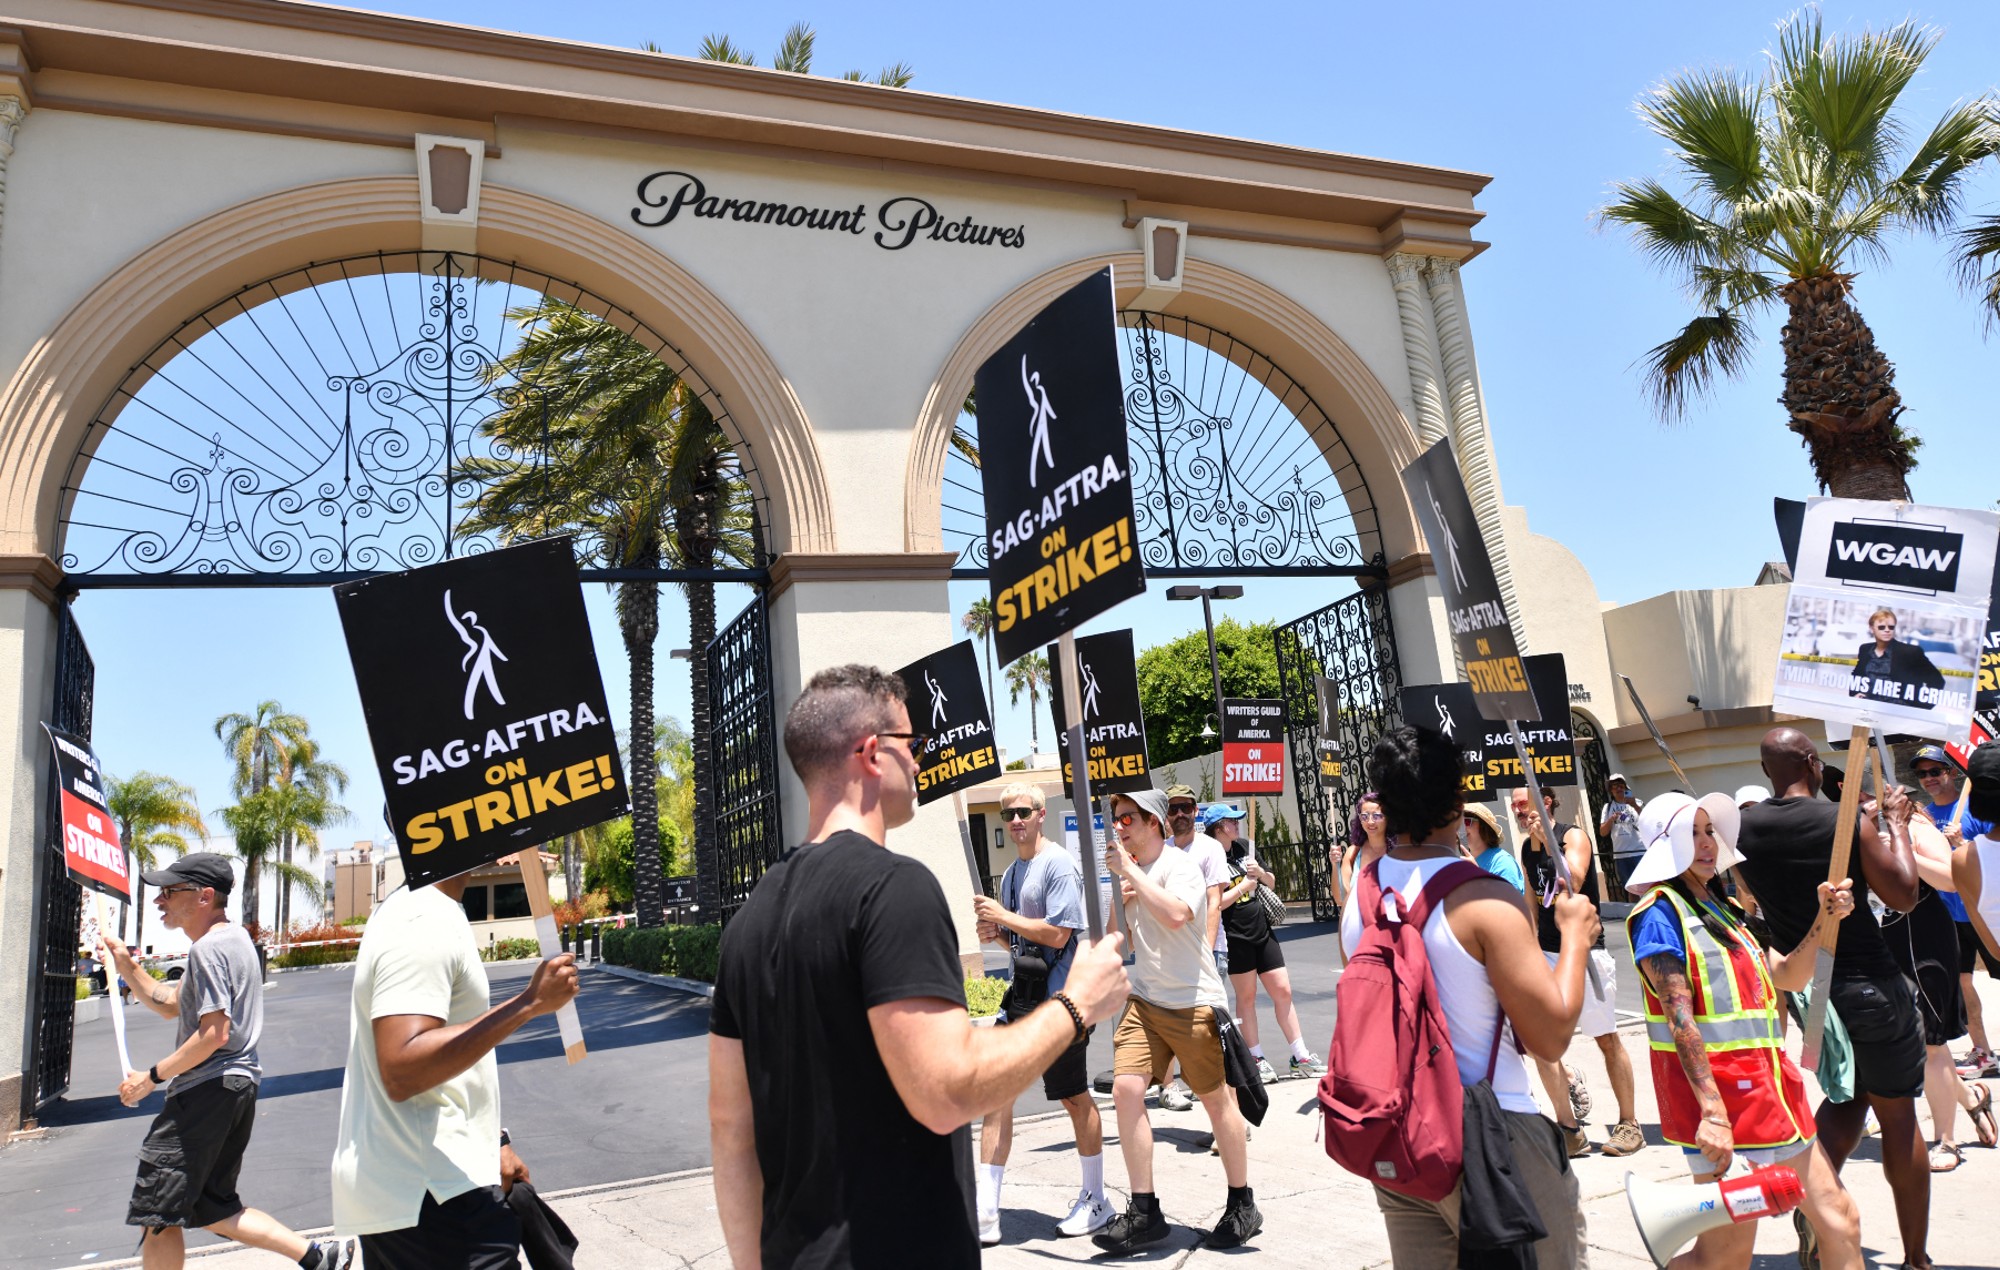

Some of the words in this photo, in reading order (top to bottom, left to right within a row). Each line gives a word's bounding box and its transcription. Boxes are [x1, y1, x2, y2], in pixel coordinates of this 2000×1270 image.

[631, 171, 865, 234] Paramount
[874, 197, 1025, 250] Pictures
[1041, 525, 1067, 559] ON
[1835, 539, 1956, 572] WGAW
[996, 516, 1132, 632] STRIKE!
[1476, 637, 1491, 656] ON
[1466, 656, 1529, 694] STRIKE!
[1784, 666, 1816, 684] MINI
[1818, 672, 1870, 693] ROOMS
[1872, 678, 1902, 699] ARE
[1904, 683, 1915, 701] A
[1918, 685, 1968, 710] CRIME
[1226, 706, 1260, 716] WRITERS
[1260, 706, 1281, 716] GUILD
[1250, 718, 1259, 726] OF
[1238, 730, 1271, 738] AMERICA
[940, 747, 956, 760] ON
[1090, 746, 1106, 758] ON
[1248, 749, 1261, 760] ON
[1525, 747, 1535, 756] N
[485, 757, 527, 785] ON
[917, 746, 995, 791] STRIKE!
[1064, 754, 1145, 782] SRIKE!
[1225, 763, 1281, 782] STRIKE!
[406, 754, 615, 855] STRIKE!
[86, 812, 103, 834] ON
[66, 823, 126, 878] STRIKE!
